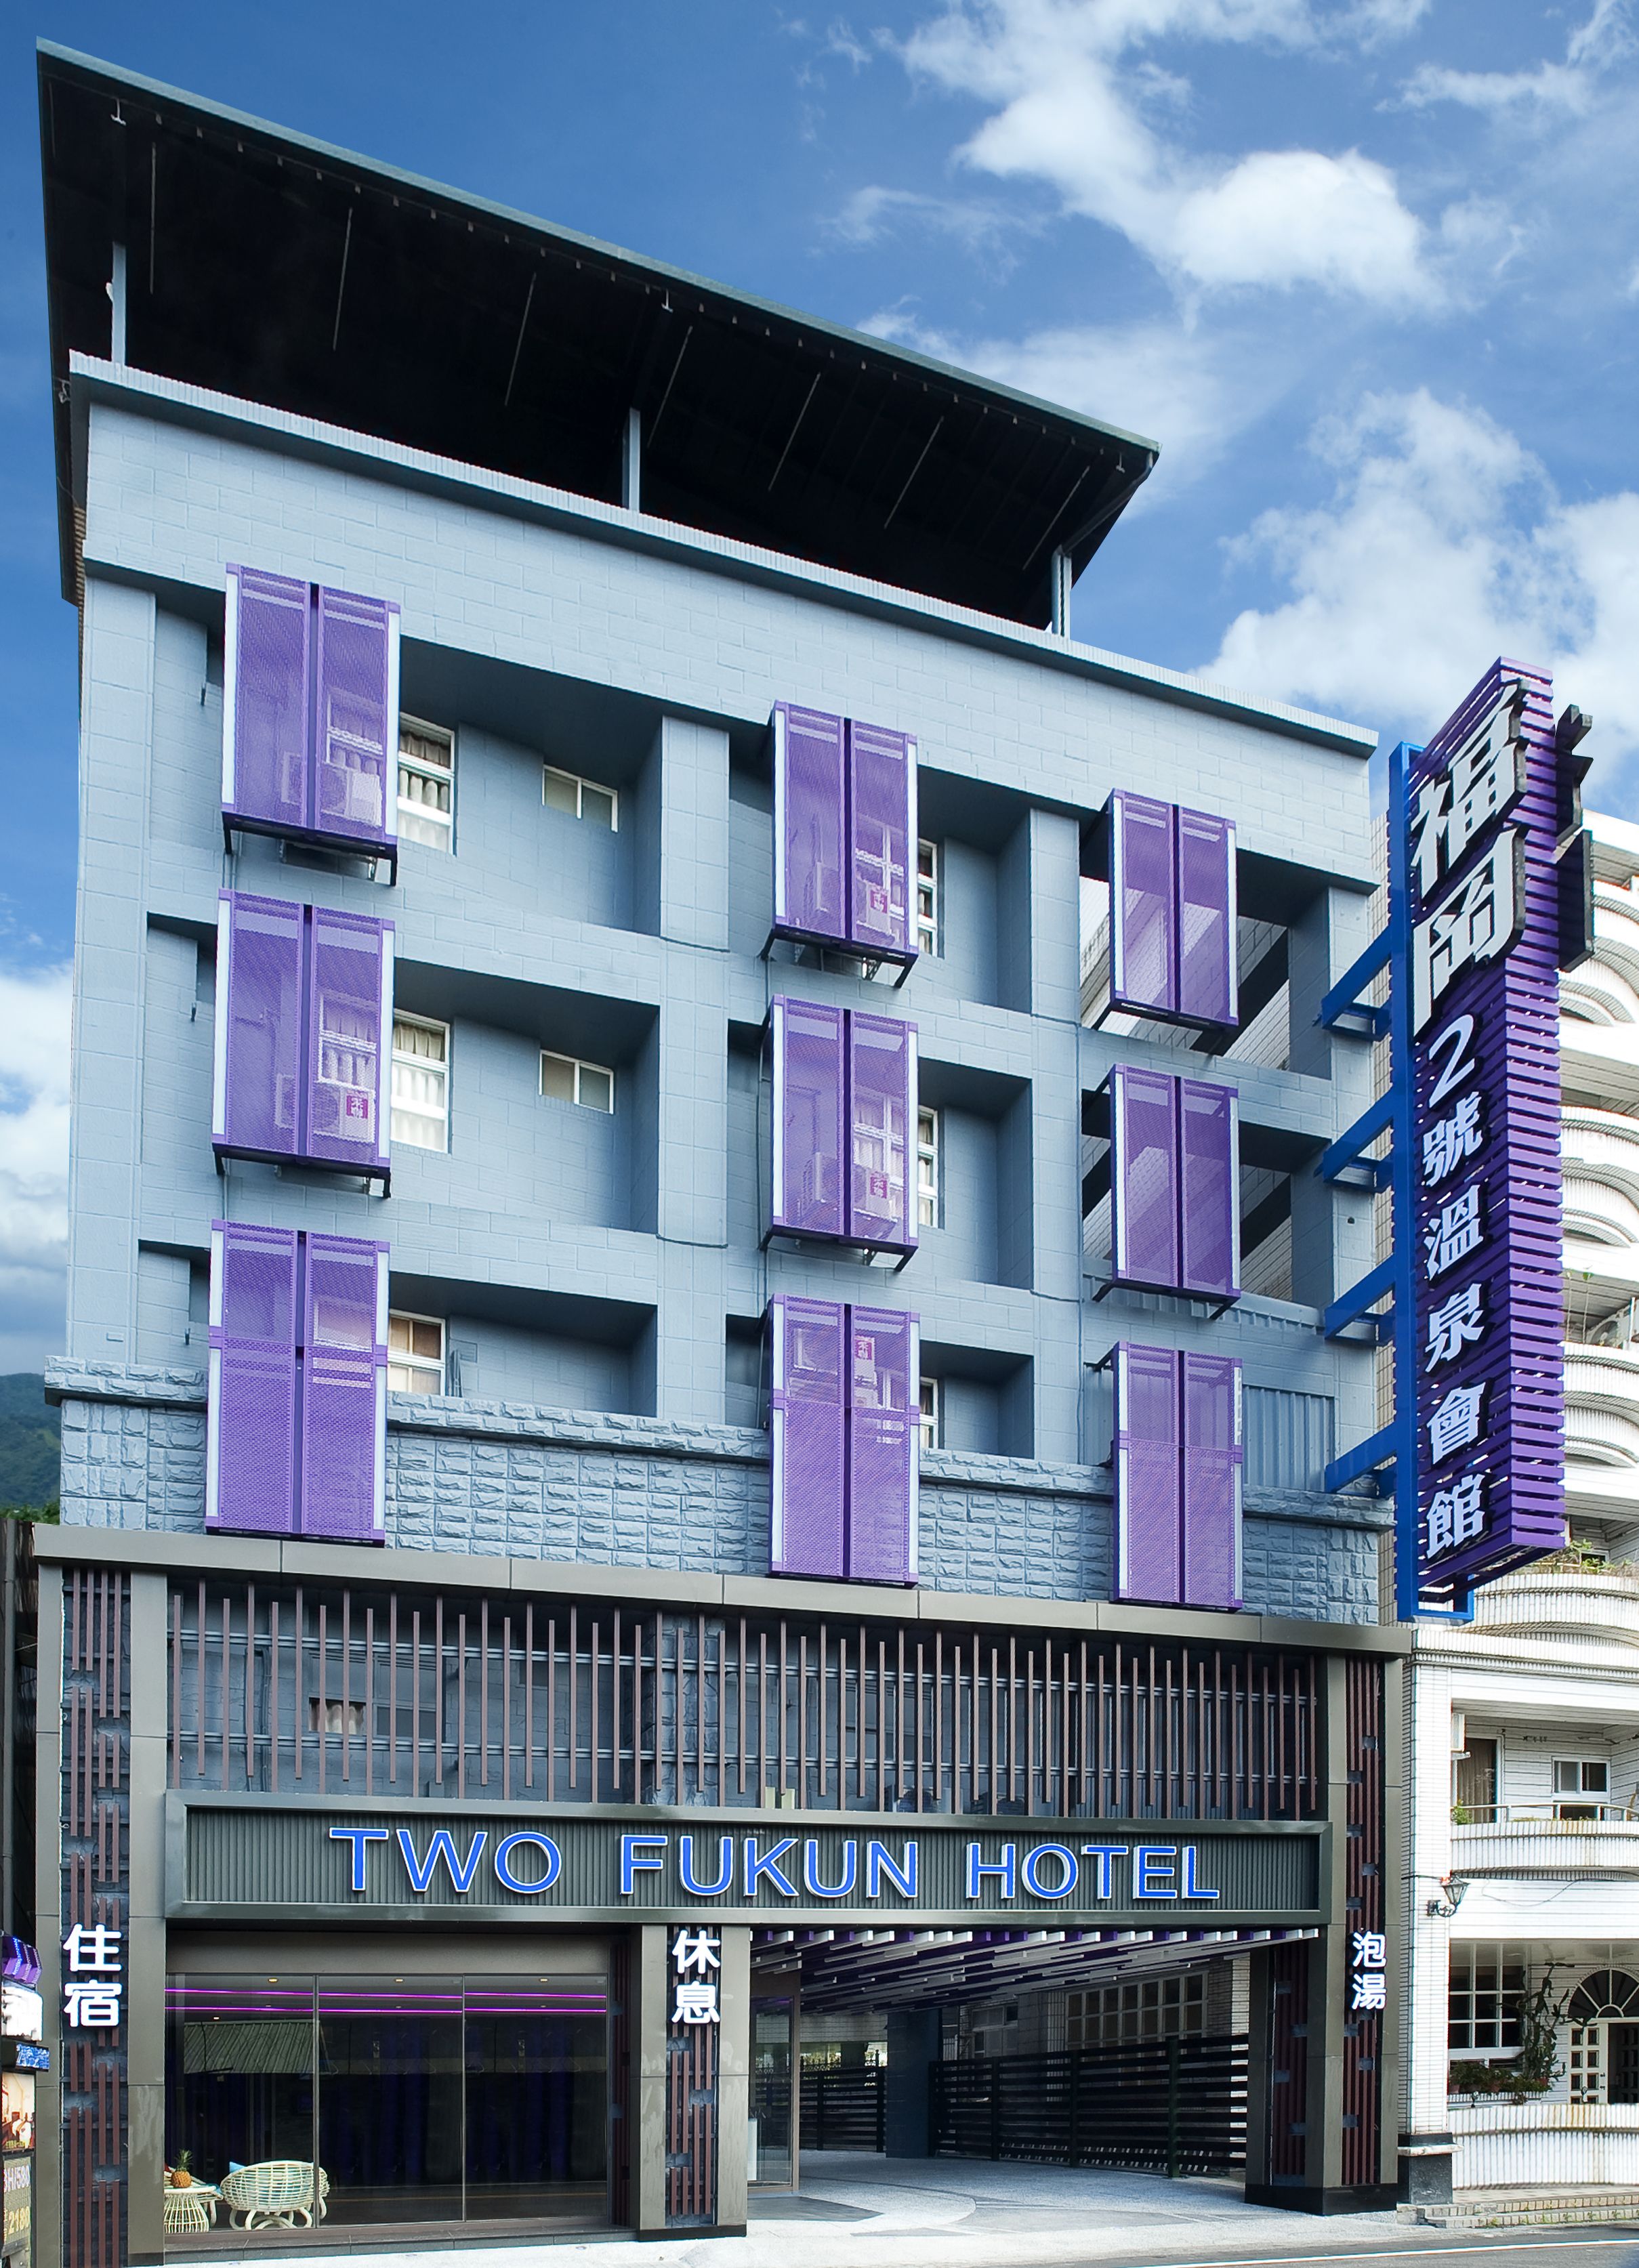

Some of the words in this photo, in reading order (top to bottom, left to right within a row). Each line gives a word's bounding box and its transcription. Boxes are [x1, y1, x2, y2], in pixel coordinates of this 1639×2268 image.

[329, 1827, 562, 1894] TWO
[620, 1834, 919, 1898] FUKUN
[966, 1842, 1220, 1900] HOTEL
[63, 1923, 122, 2027] 住宿
[671, 1929, 721, 2023] 休息
[1352, 1931, 1387, 2010] 泡湯
